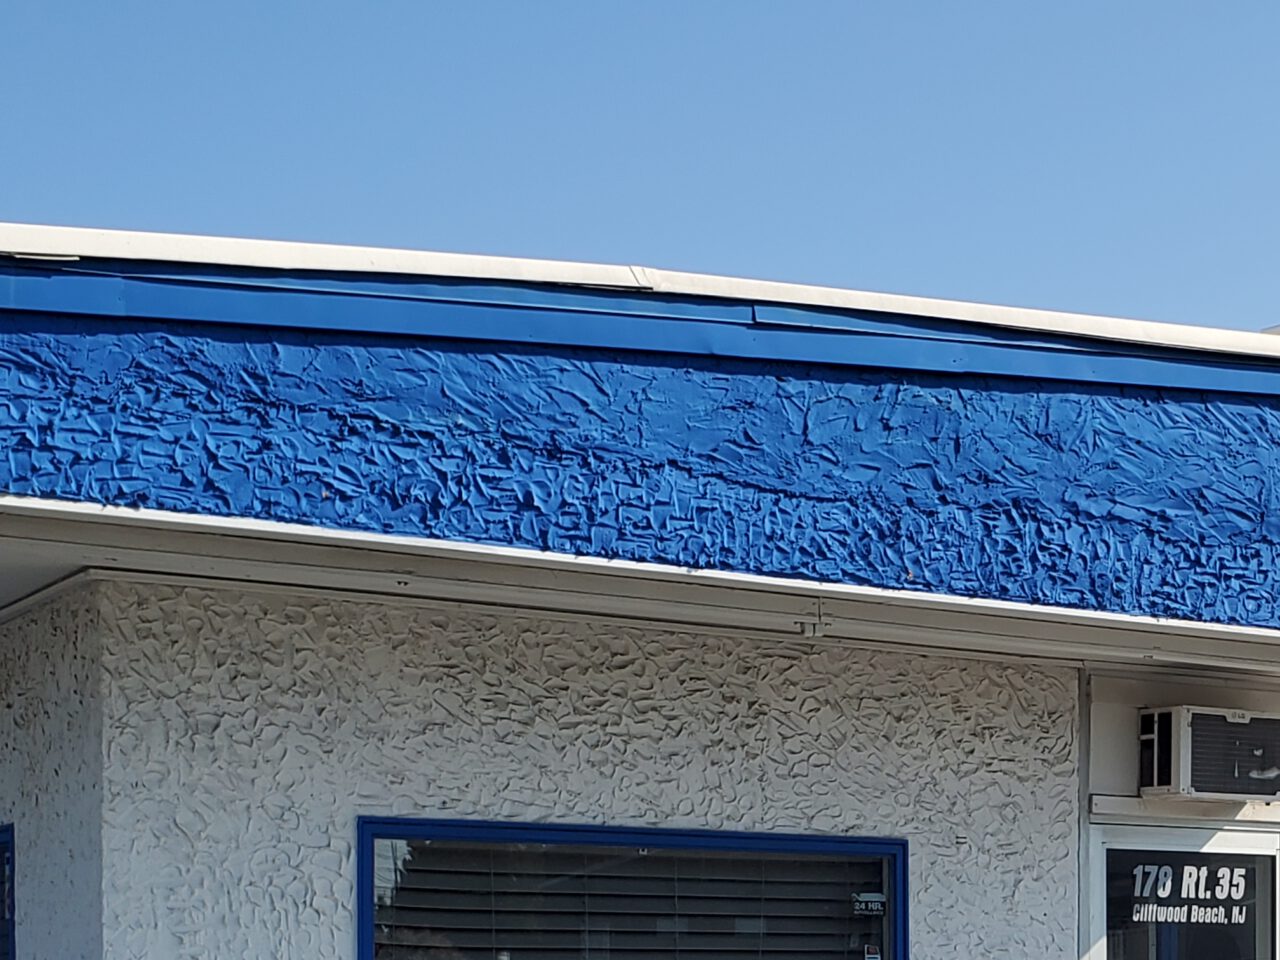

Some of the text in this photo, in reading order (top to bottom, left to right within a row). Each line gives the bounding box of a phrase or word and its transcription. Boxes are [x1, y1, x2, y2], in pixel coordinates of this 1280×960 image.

[1132, 864, 1246, 900] 178 Rt. 35
[854, 902, 865, 910] 24
[1132, 903, 1246, 924] Cliffwood Beach, NJ
